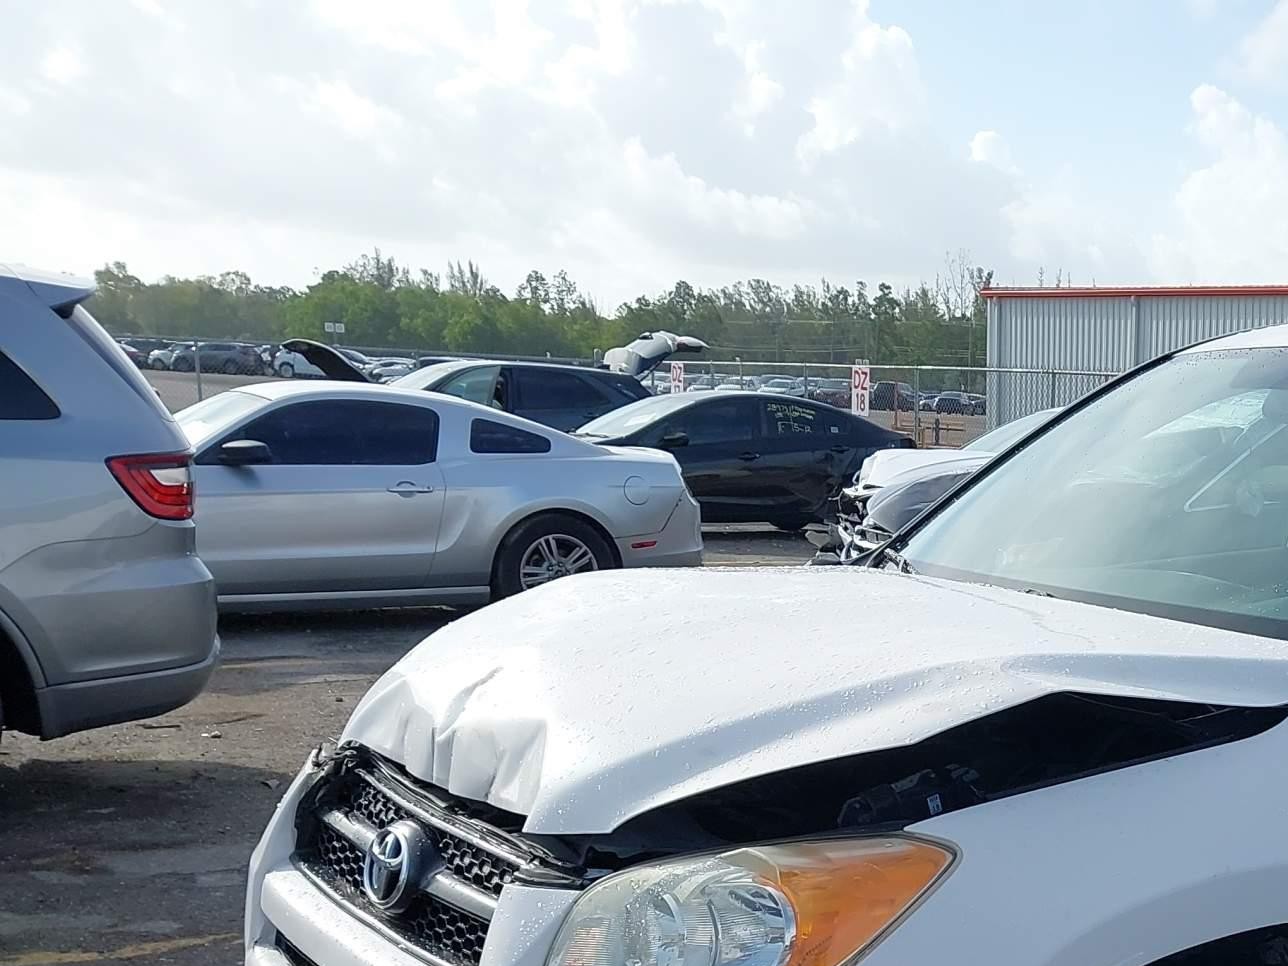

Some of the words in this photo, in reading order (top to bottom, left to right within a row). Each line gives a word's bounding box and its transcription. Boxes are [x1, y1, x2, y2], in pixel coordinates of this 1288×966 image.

[672, 365, 682, 383] DZ
[854, 370, 868, 390] DZ
[856, 393, 866, 411] 18
